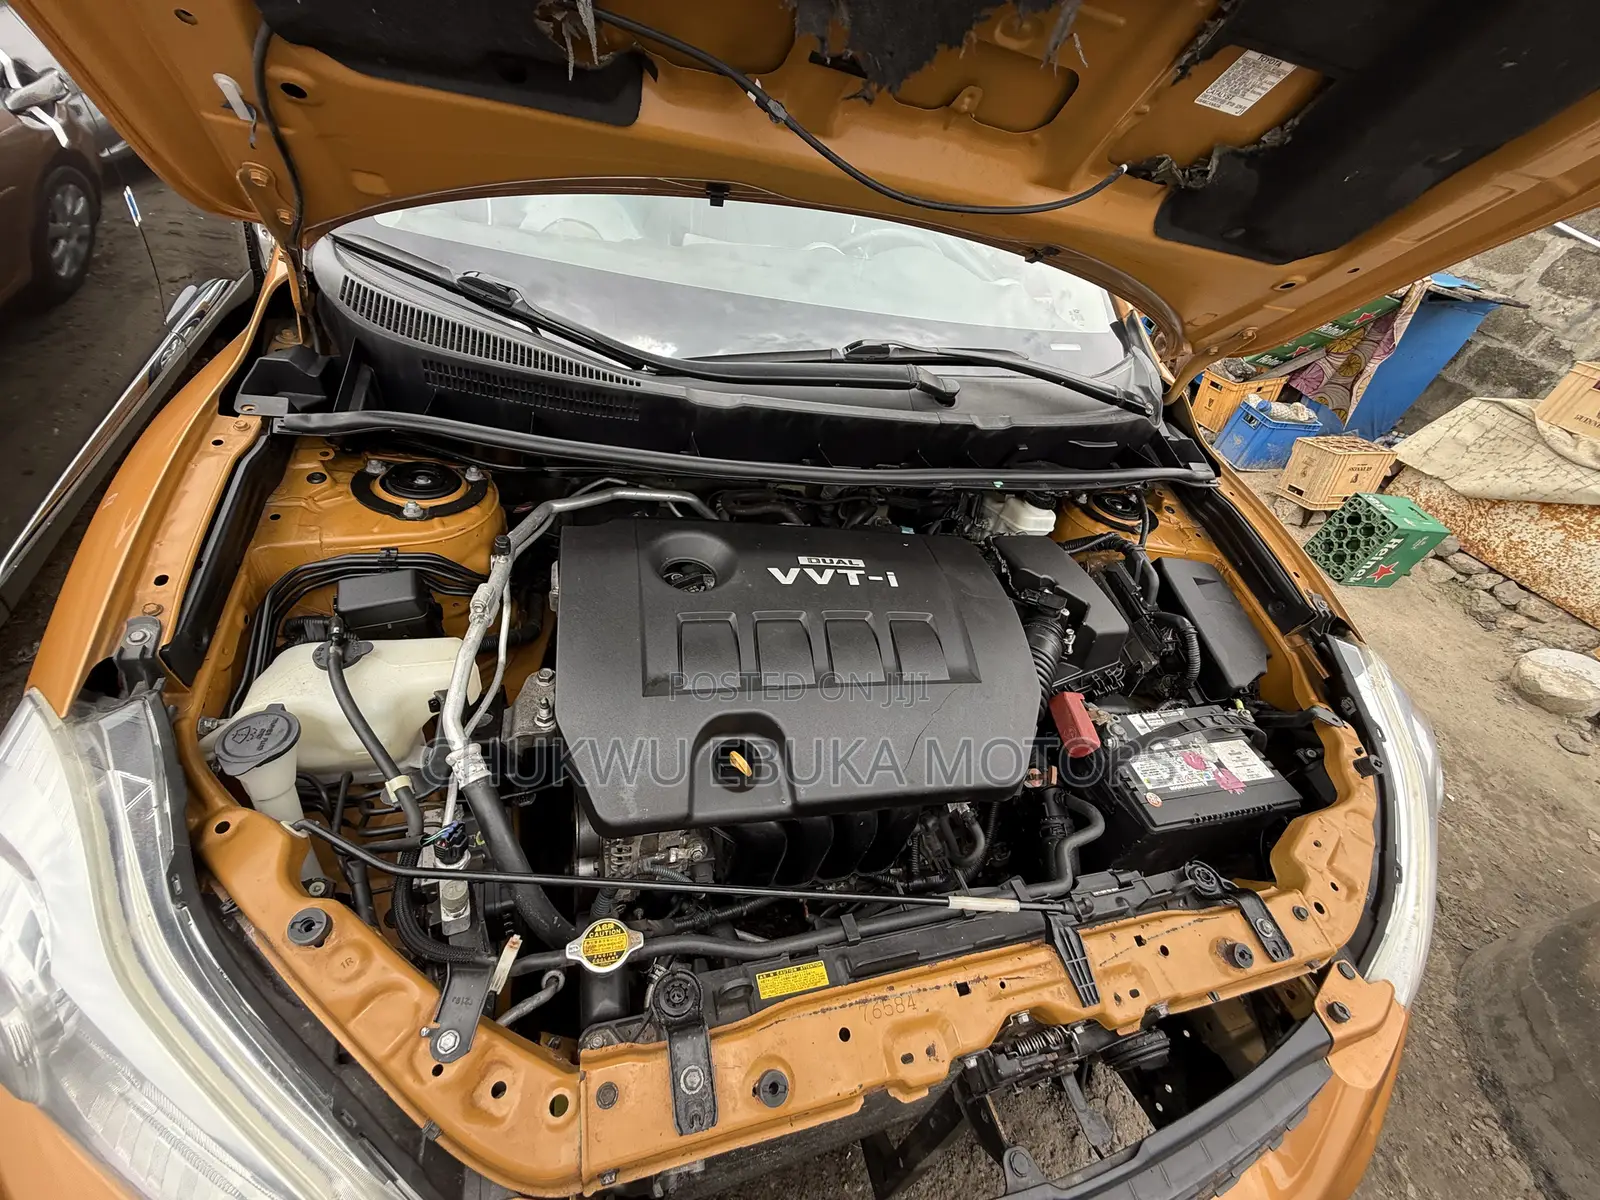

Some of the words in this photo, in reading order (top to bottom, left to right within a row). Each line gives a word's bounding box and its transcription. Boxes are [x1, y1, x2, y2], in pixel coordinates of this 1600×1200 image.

[1257, 54, 1284, 68] TOYOTA
[1205, 88, 1235, 101] CATALYST
[806, 557, 861, 567] DUAL
[767, 567, 899, 588] VVT-i
[589, 929, 621, 938] CAUTION
[858, 994, 917, 1022] 76584
